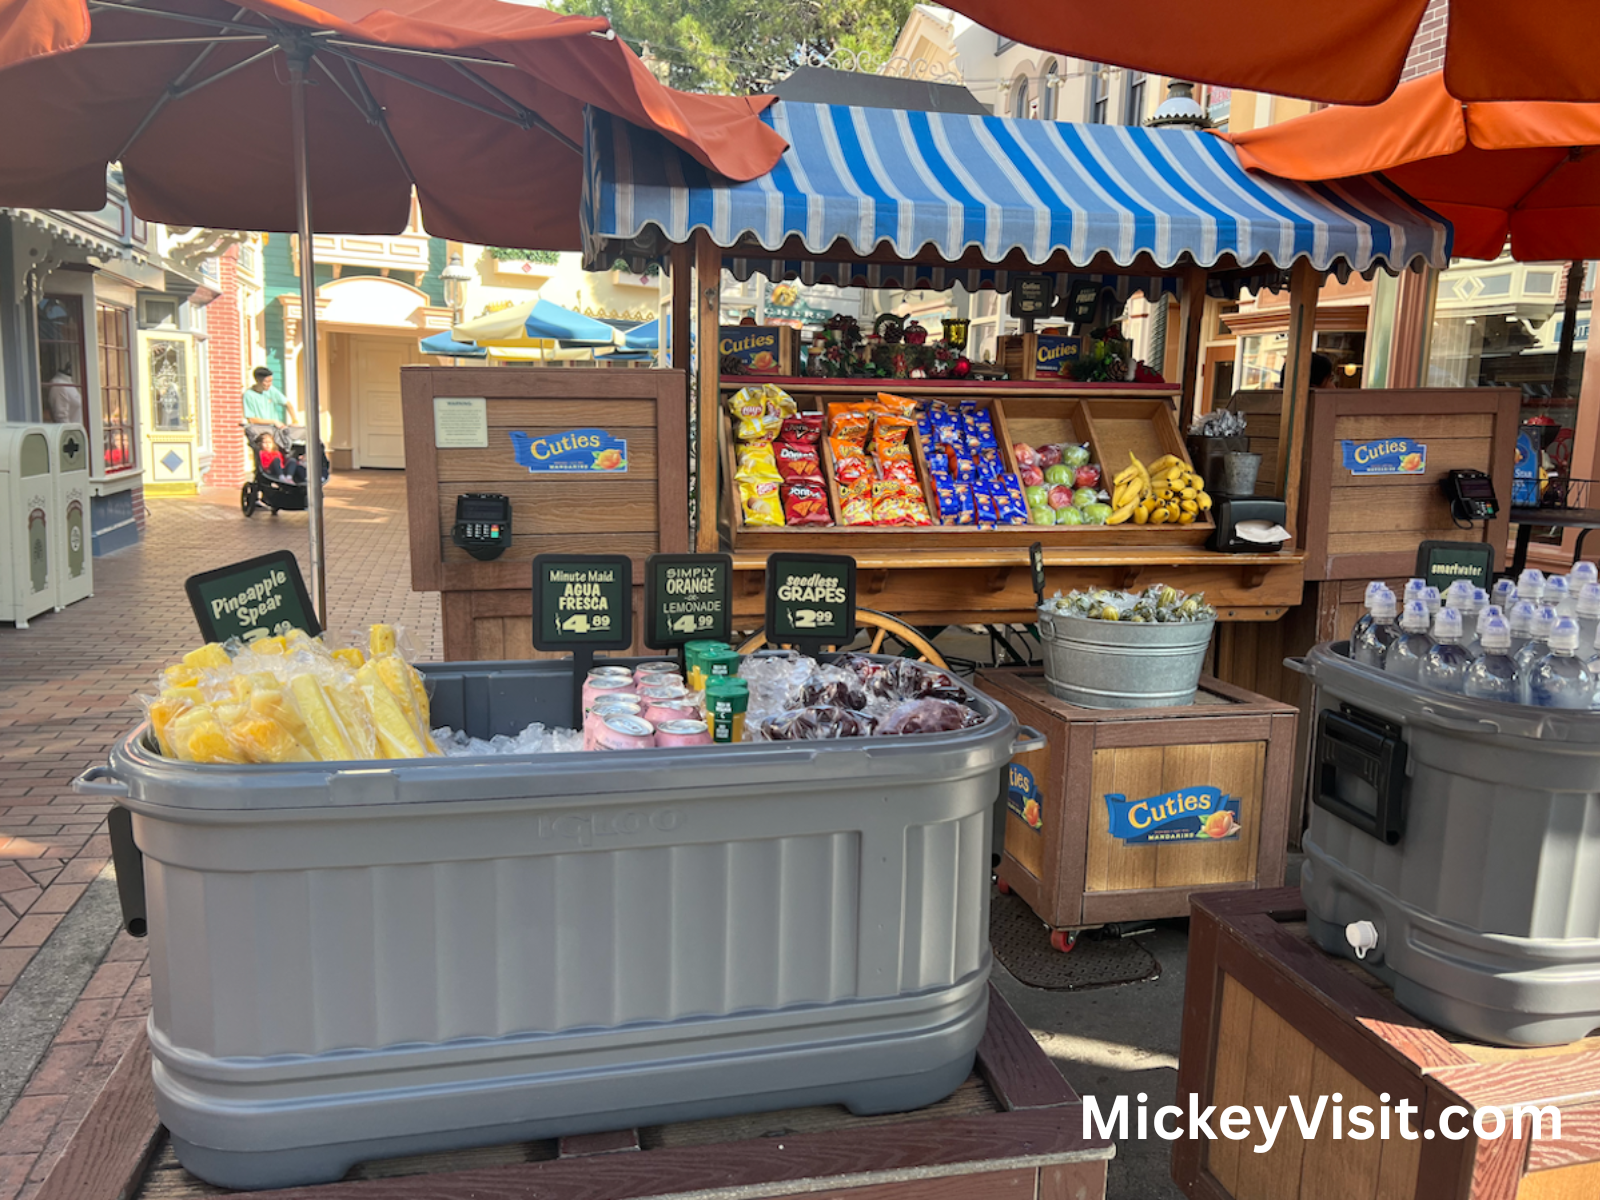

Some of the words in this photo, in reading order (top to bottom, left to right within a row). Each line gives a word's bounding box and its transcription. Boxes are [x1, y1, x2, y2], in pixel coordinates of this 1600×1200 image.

[719, 333, 775, 356] Cuties
[1037, 343, 1078, 362] Cuties
[530, 433, 601, 460] Cuties
[1354, 440, 1407, 464] Cuties
[549, 569, 587, 582] Minute
[588, 569, 614, 582] Maid
[666, 567, 717, 579] SIMPLY
[786, 573, 839, 588] seedless
[211, 569, 287, 620] Pineapple
[564, 583, 601, 597] AGUA
[666, 577, 716, 595] ORANGE
[777, 585, 846, 604] GRAPES
[236, 594, 282, 627] Spear
[558, 596, 609, 610] FRESCA
[662, 601, 721, 614] LEMONADE
[1128, 793, 1211, 829] Cuties
